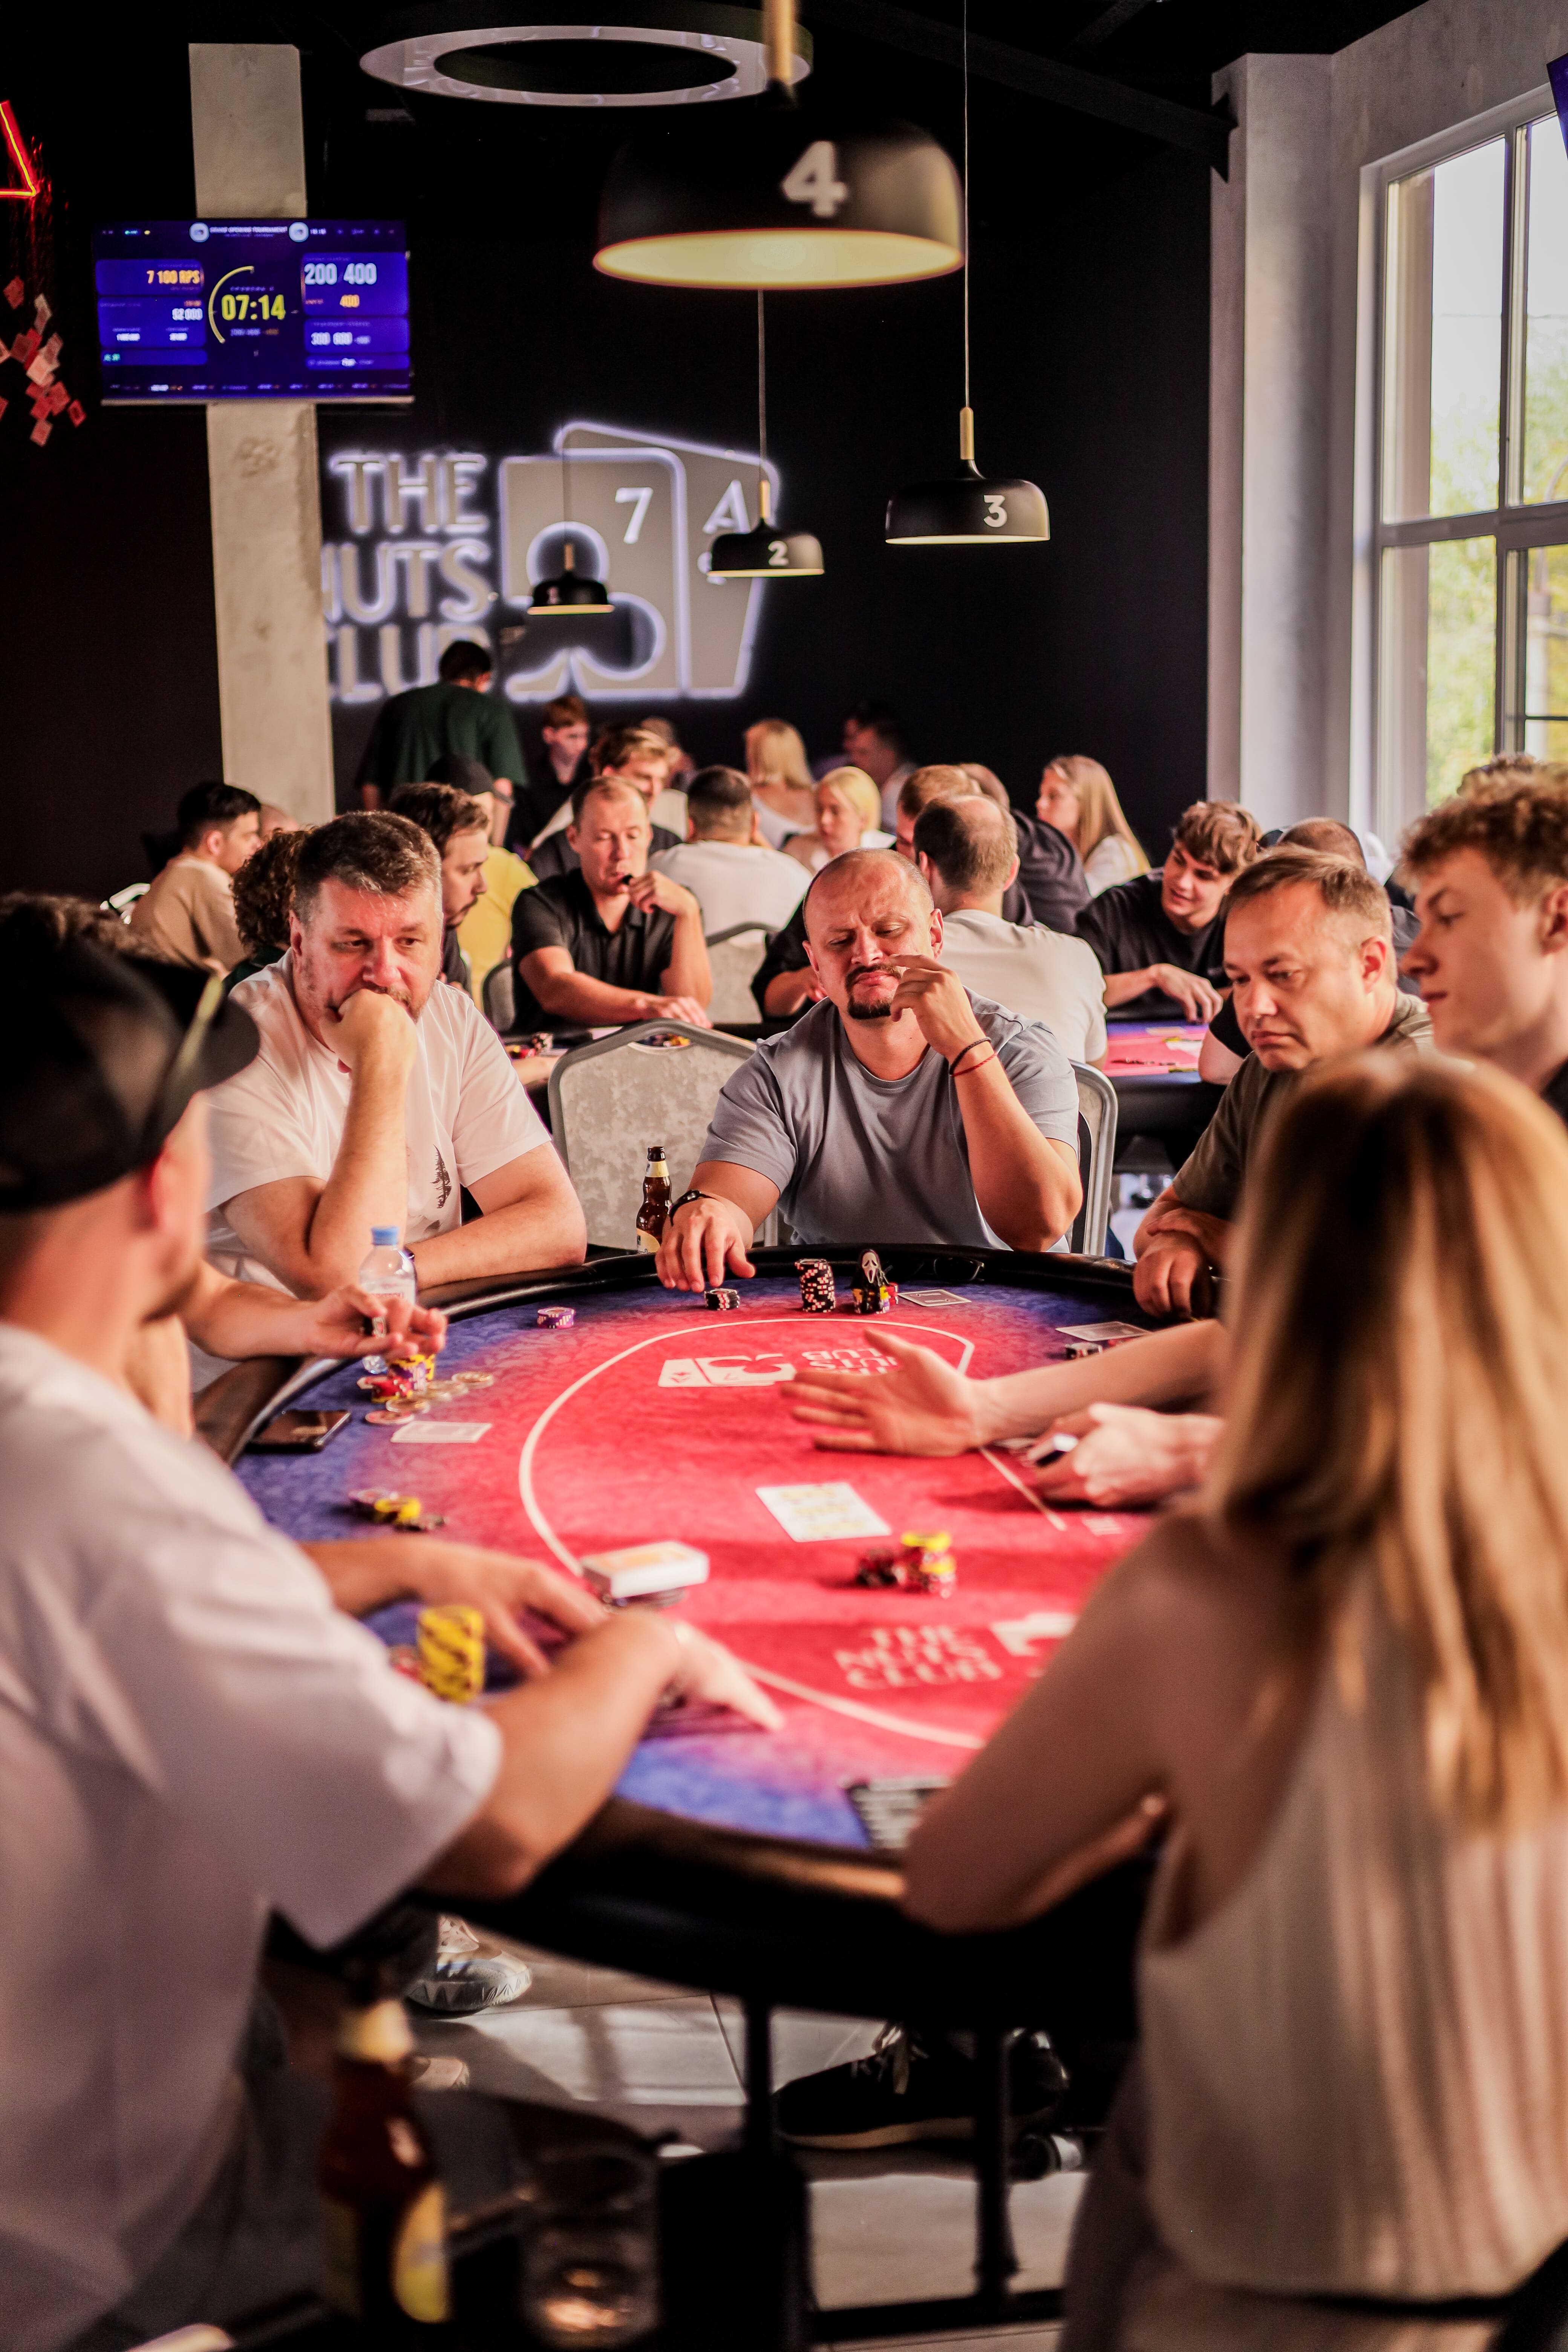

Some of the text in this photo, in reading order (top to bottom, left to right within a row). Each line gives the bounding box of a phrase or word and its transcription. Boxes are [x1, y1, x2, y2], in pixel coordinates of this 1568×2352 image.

[782, 141, 848, 216] 4
[147, 270, 154, 283] 7
[157, 270, 178, 283] 100
[304, 263, 377, 285] 200 400
[221, 294, 286, 320] 07:14
[327, 452, 489, 535] THE
[702, 480, 751, 535] A
[615, 487, 653, 544] 7
[983, 495, 1008, 528] 3
[768, 541, 789, 565] 2
[802, 1348, 883, 1361] LUB
